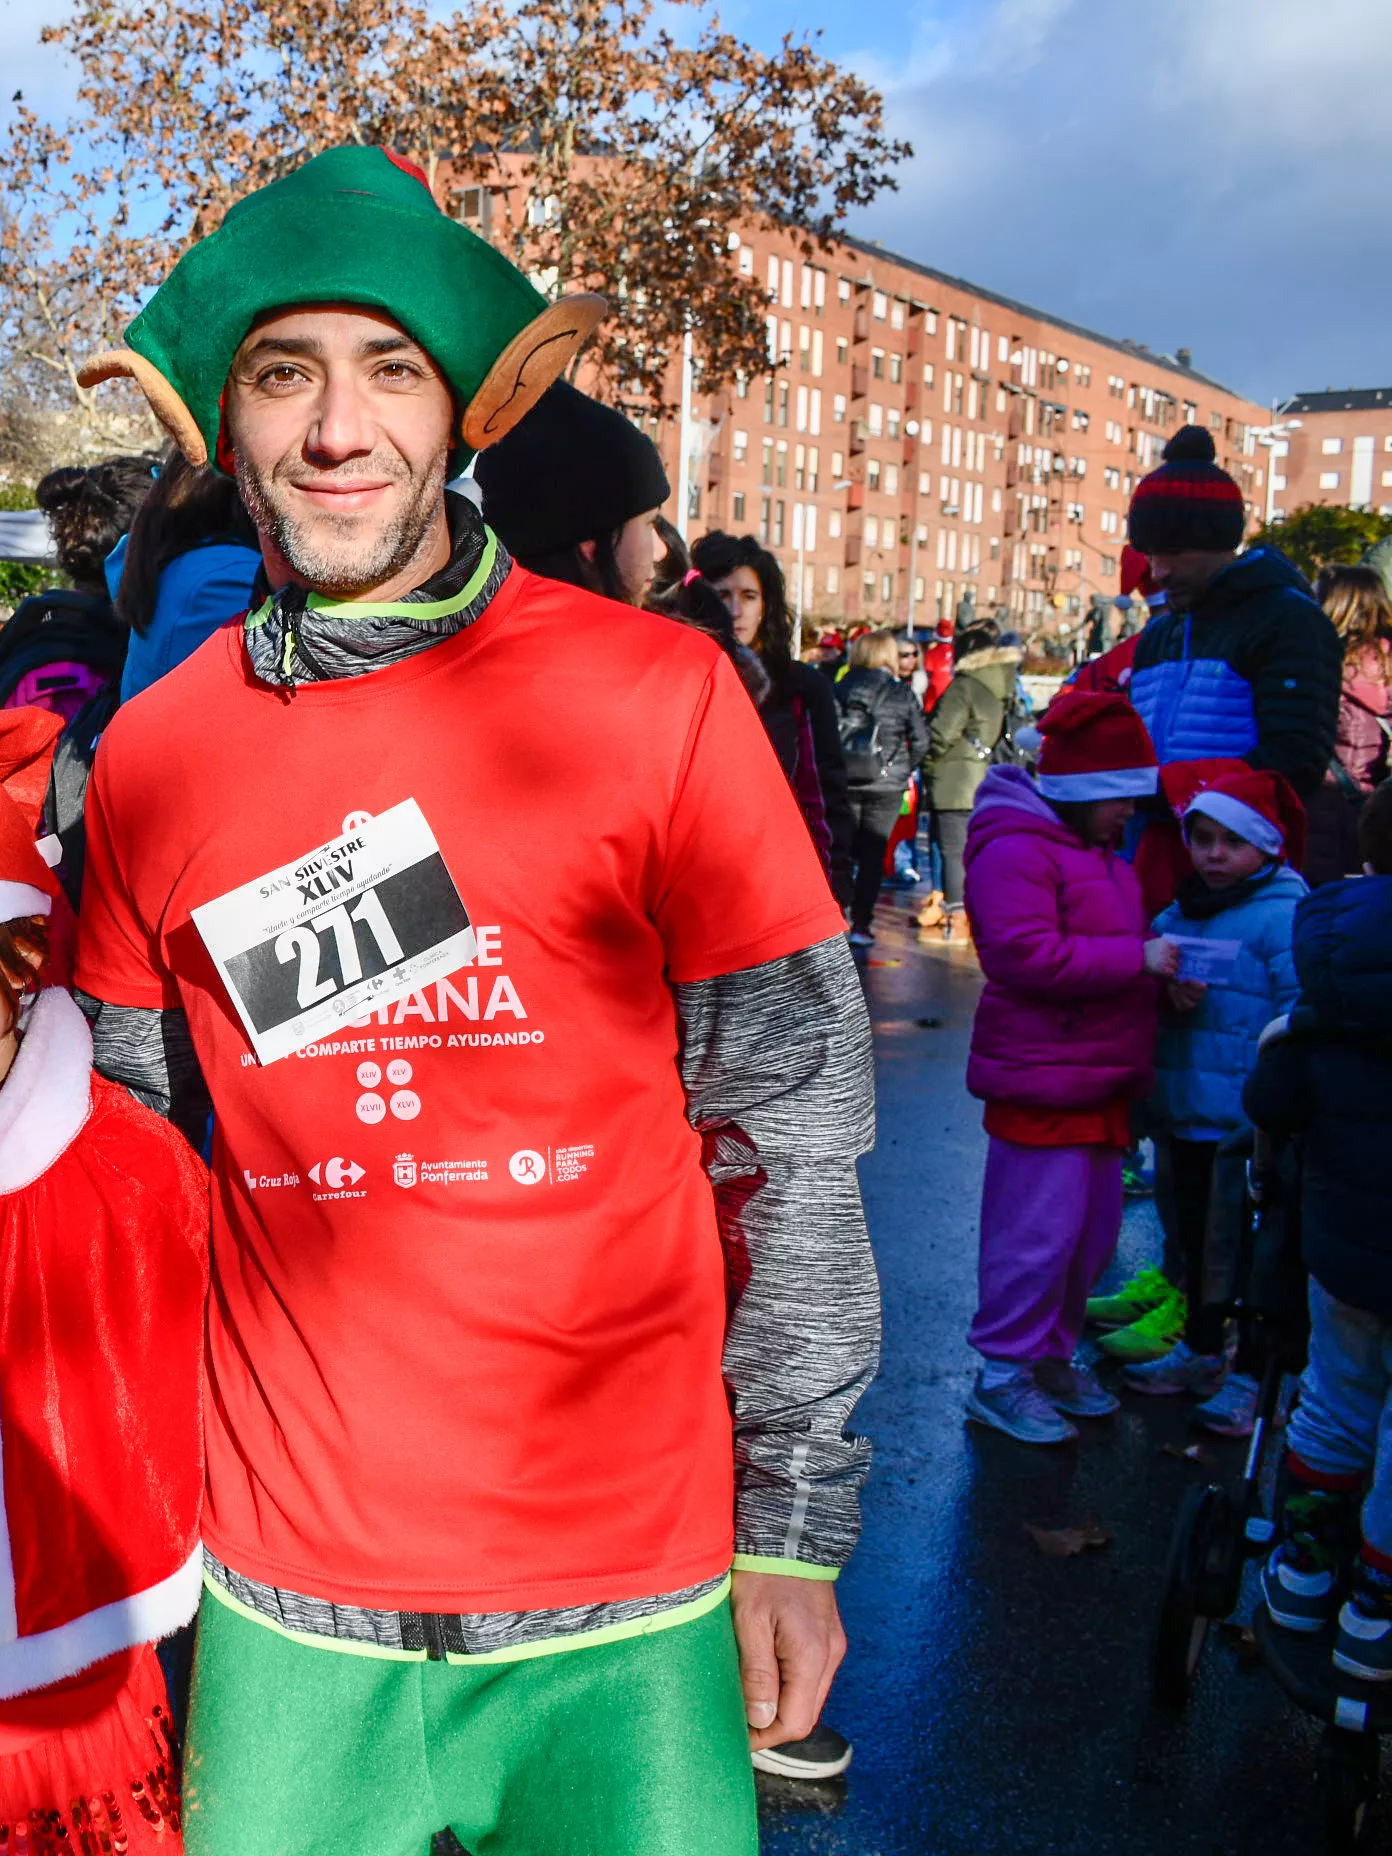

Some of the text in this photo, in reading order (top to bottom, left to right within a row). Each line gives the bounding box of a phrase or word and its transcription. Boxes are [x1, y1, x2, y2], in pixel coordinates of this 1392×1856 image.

[259, 837, 366, 899] SAN SILVESTRE
[296, 860, 354, 905] XLIV
[275, 887, 405, 1009] 271
[466, 926, 503, 967] E
[295, 1038, 376, 1059] COMPARTE
[381, 1035, 442, 1052] TIEMPO
[447, 1030, 545, 1048] AYUDANDO
[360, 1070, 377, 1079] XLIV
[392, 1068, 406, 1076] XLV
[360, 1103, 381, 1112] XLVII
[396, 1100, 415, 1109] XLVI
[556, 1150, 595, 1161] RUNNING
[421, 1159, 488, 1171] Ayuntamiento
[556, 1158, 579, 1168] PARA
[557, 1164, 587, 1175] TODOS
[259, 1172, 300, 1188] Cruz Roja
[421, 1171, 488, 1186] Ponferrada
[312, 1190, 368, 1201] Carrefour
